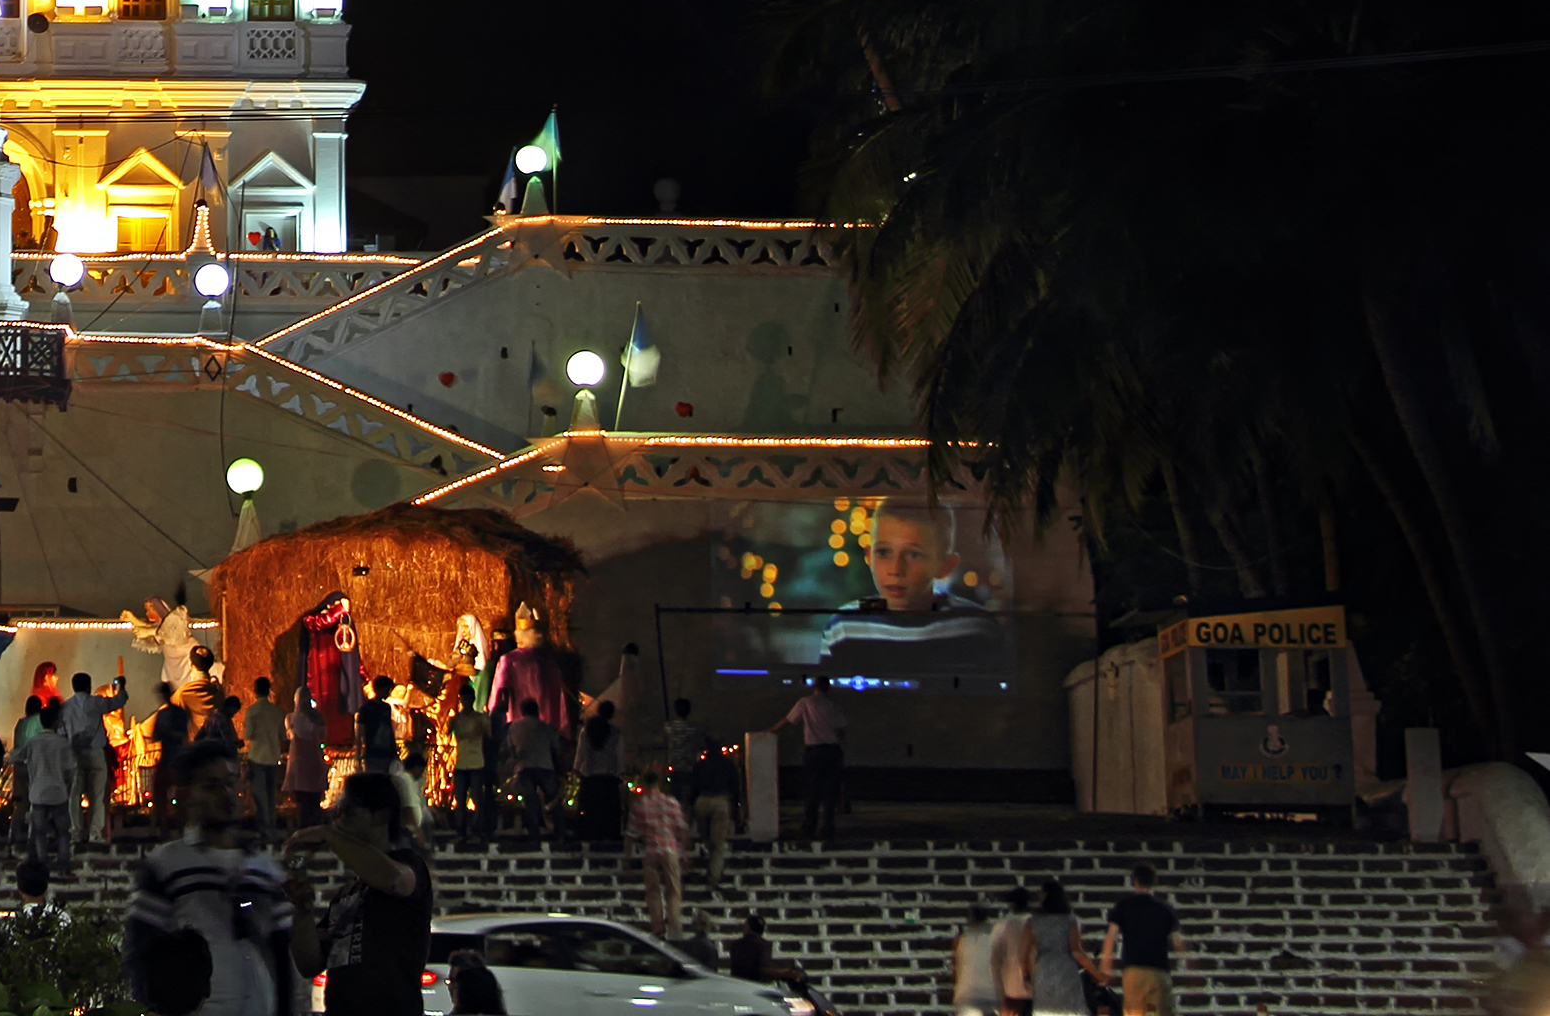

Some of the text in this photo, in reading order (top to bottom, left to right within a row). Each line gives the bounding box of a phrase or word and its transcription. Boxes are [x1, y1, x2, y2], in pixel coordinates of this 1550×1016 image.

[1196, 622, 1244, 644] GOA
[1253, 622, 1337, 645] POLICE
[1220, 765, 1247, 780] MAY
[1262, 765, 1295, 780] HELP
